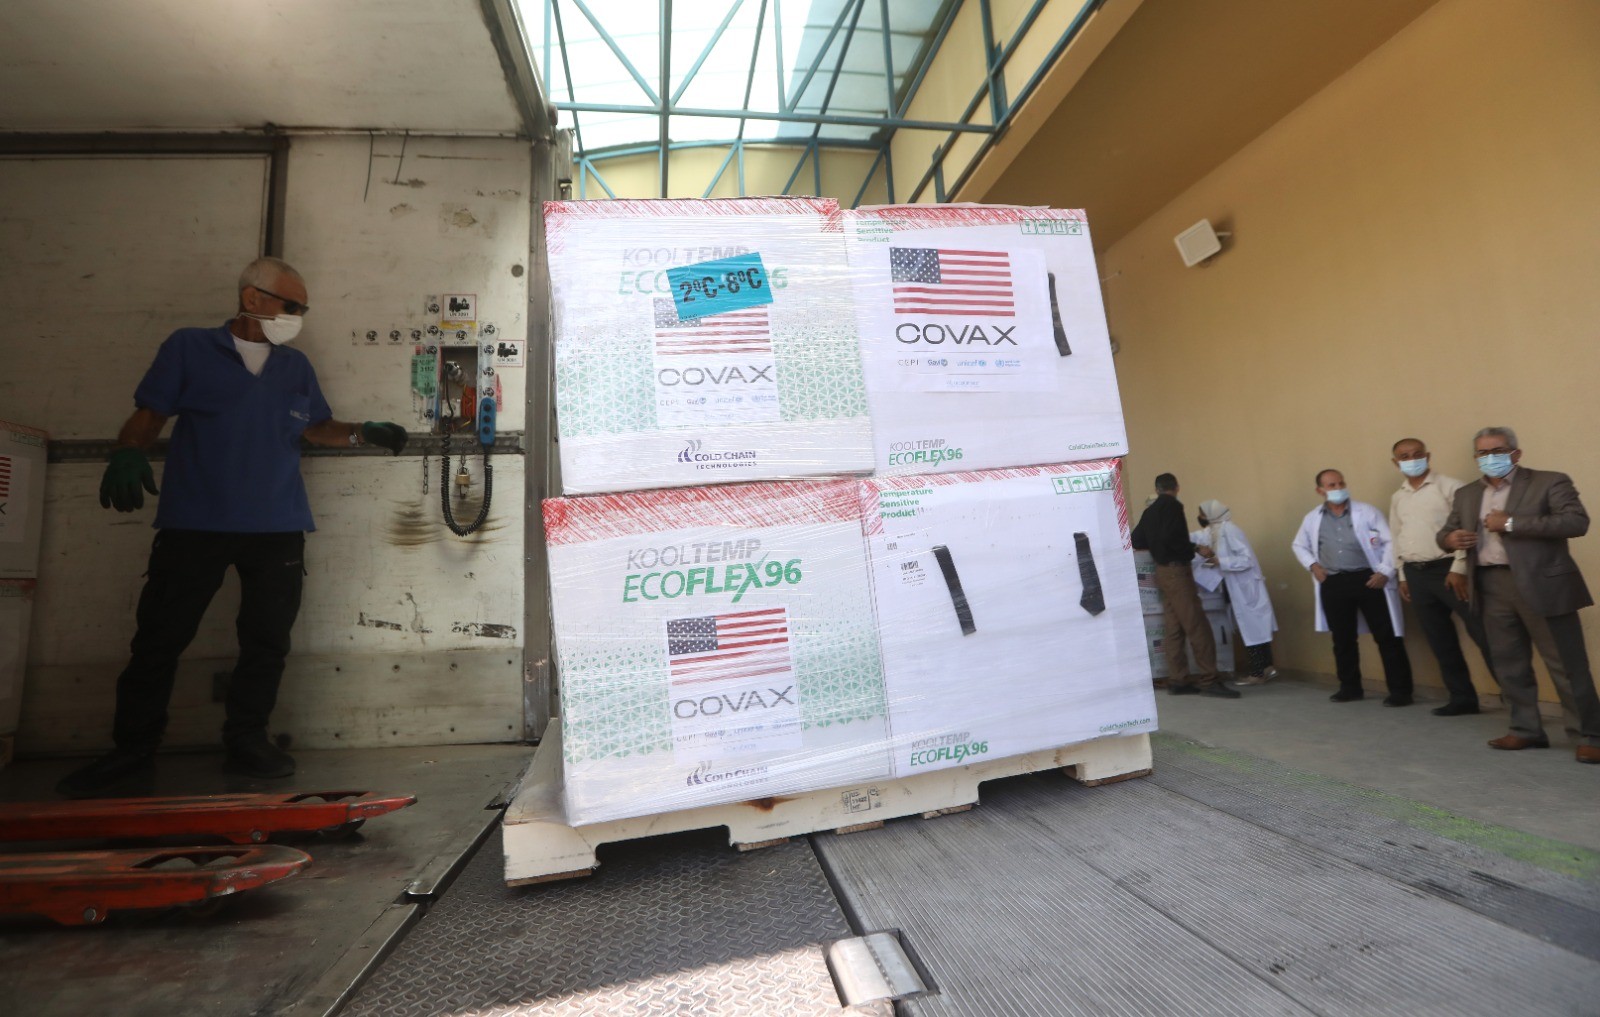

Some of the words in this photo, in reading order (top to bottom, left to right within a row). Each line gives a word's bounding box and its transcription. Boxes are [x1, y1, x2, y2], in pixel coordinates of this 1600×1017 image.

[856, 227, 894, 235] Sensitive
[895, 322, 1018, 346] COVAX
[657, 364, 774, 387] COVAX
[889, 438, 946, 451] KOOLTEMP
[1068, 441, 1120, 452] ColdChainTech.com
[694, 453, 722, 462] COLD
[723, 450, 756, 460] CHAIN
[888, 447, 963, 467] ECOFLEX96
[696, 461, 758, 470] TECHNOLOGIES
[879, 488, 934, 498] Temperature
[879, 498, 920, 509] Sensitive
[880, 509, 916, 520] Product
[626, 538, 762, 570] KOOLTEMP
[622, 551, 803, 604] ECOFLEX96
[673, 685, 796, 720] COVAX
[1099, 717, 1152, 733] ColdChainTech.com
[911, 731, 970, 750] KOOLTEMP
[910, 741, 989, 767] ECOFLEX96
